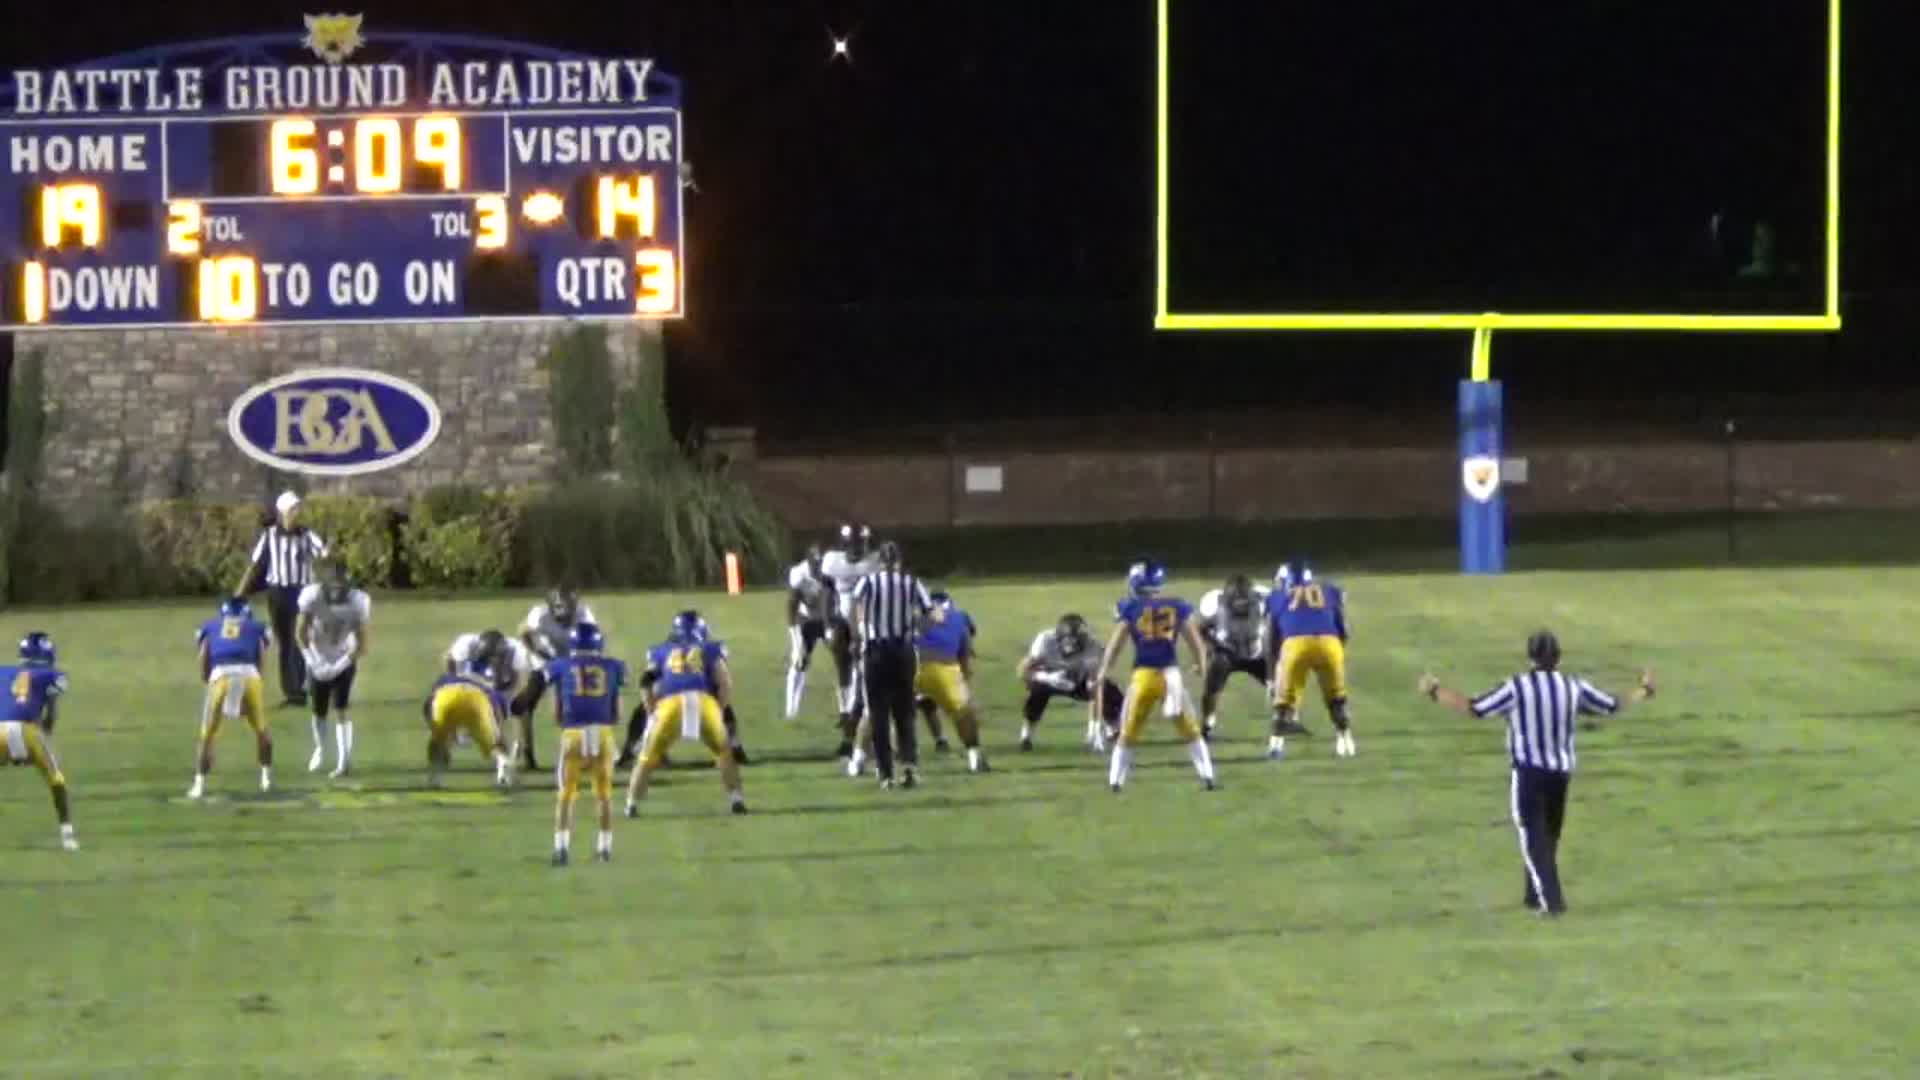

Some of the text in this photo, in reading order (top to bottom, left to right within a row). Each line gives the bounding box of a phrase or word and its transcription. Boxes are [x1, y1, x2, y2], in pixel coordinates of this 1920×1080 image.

[13, 59, 653, 114] BATTLE GROUND ACADEMY
[10, 135, 147, 173] HOME
[269, 115, 462, 194] 6:09
[512, 126, 672, 163] VISITOR
[166, 200, 201, 254] 2
[203, 216, 243, 241] TOL
[431, 211, 471, 238] TOL
[474, 193, 508, 249] 3
[48, 265, 160, 311] DOWN
[198, 256, 257, 321] 10
[262, 260, 456, 306] TO GO ON
[556, 257, 627, 307] QTR
[635, 249, 675, 313] 3
